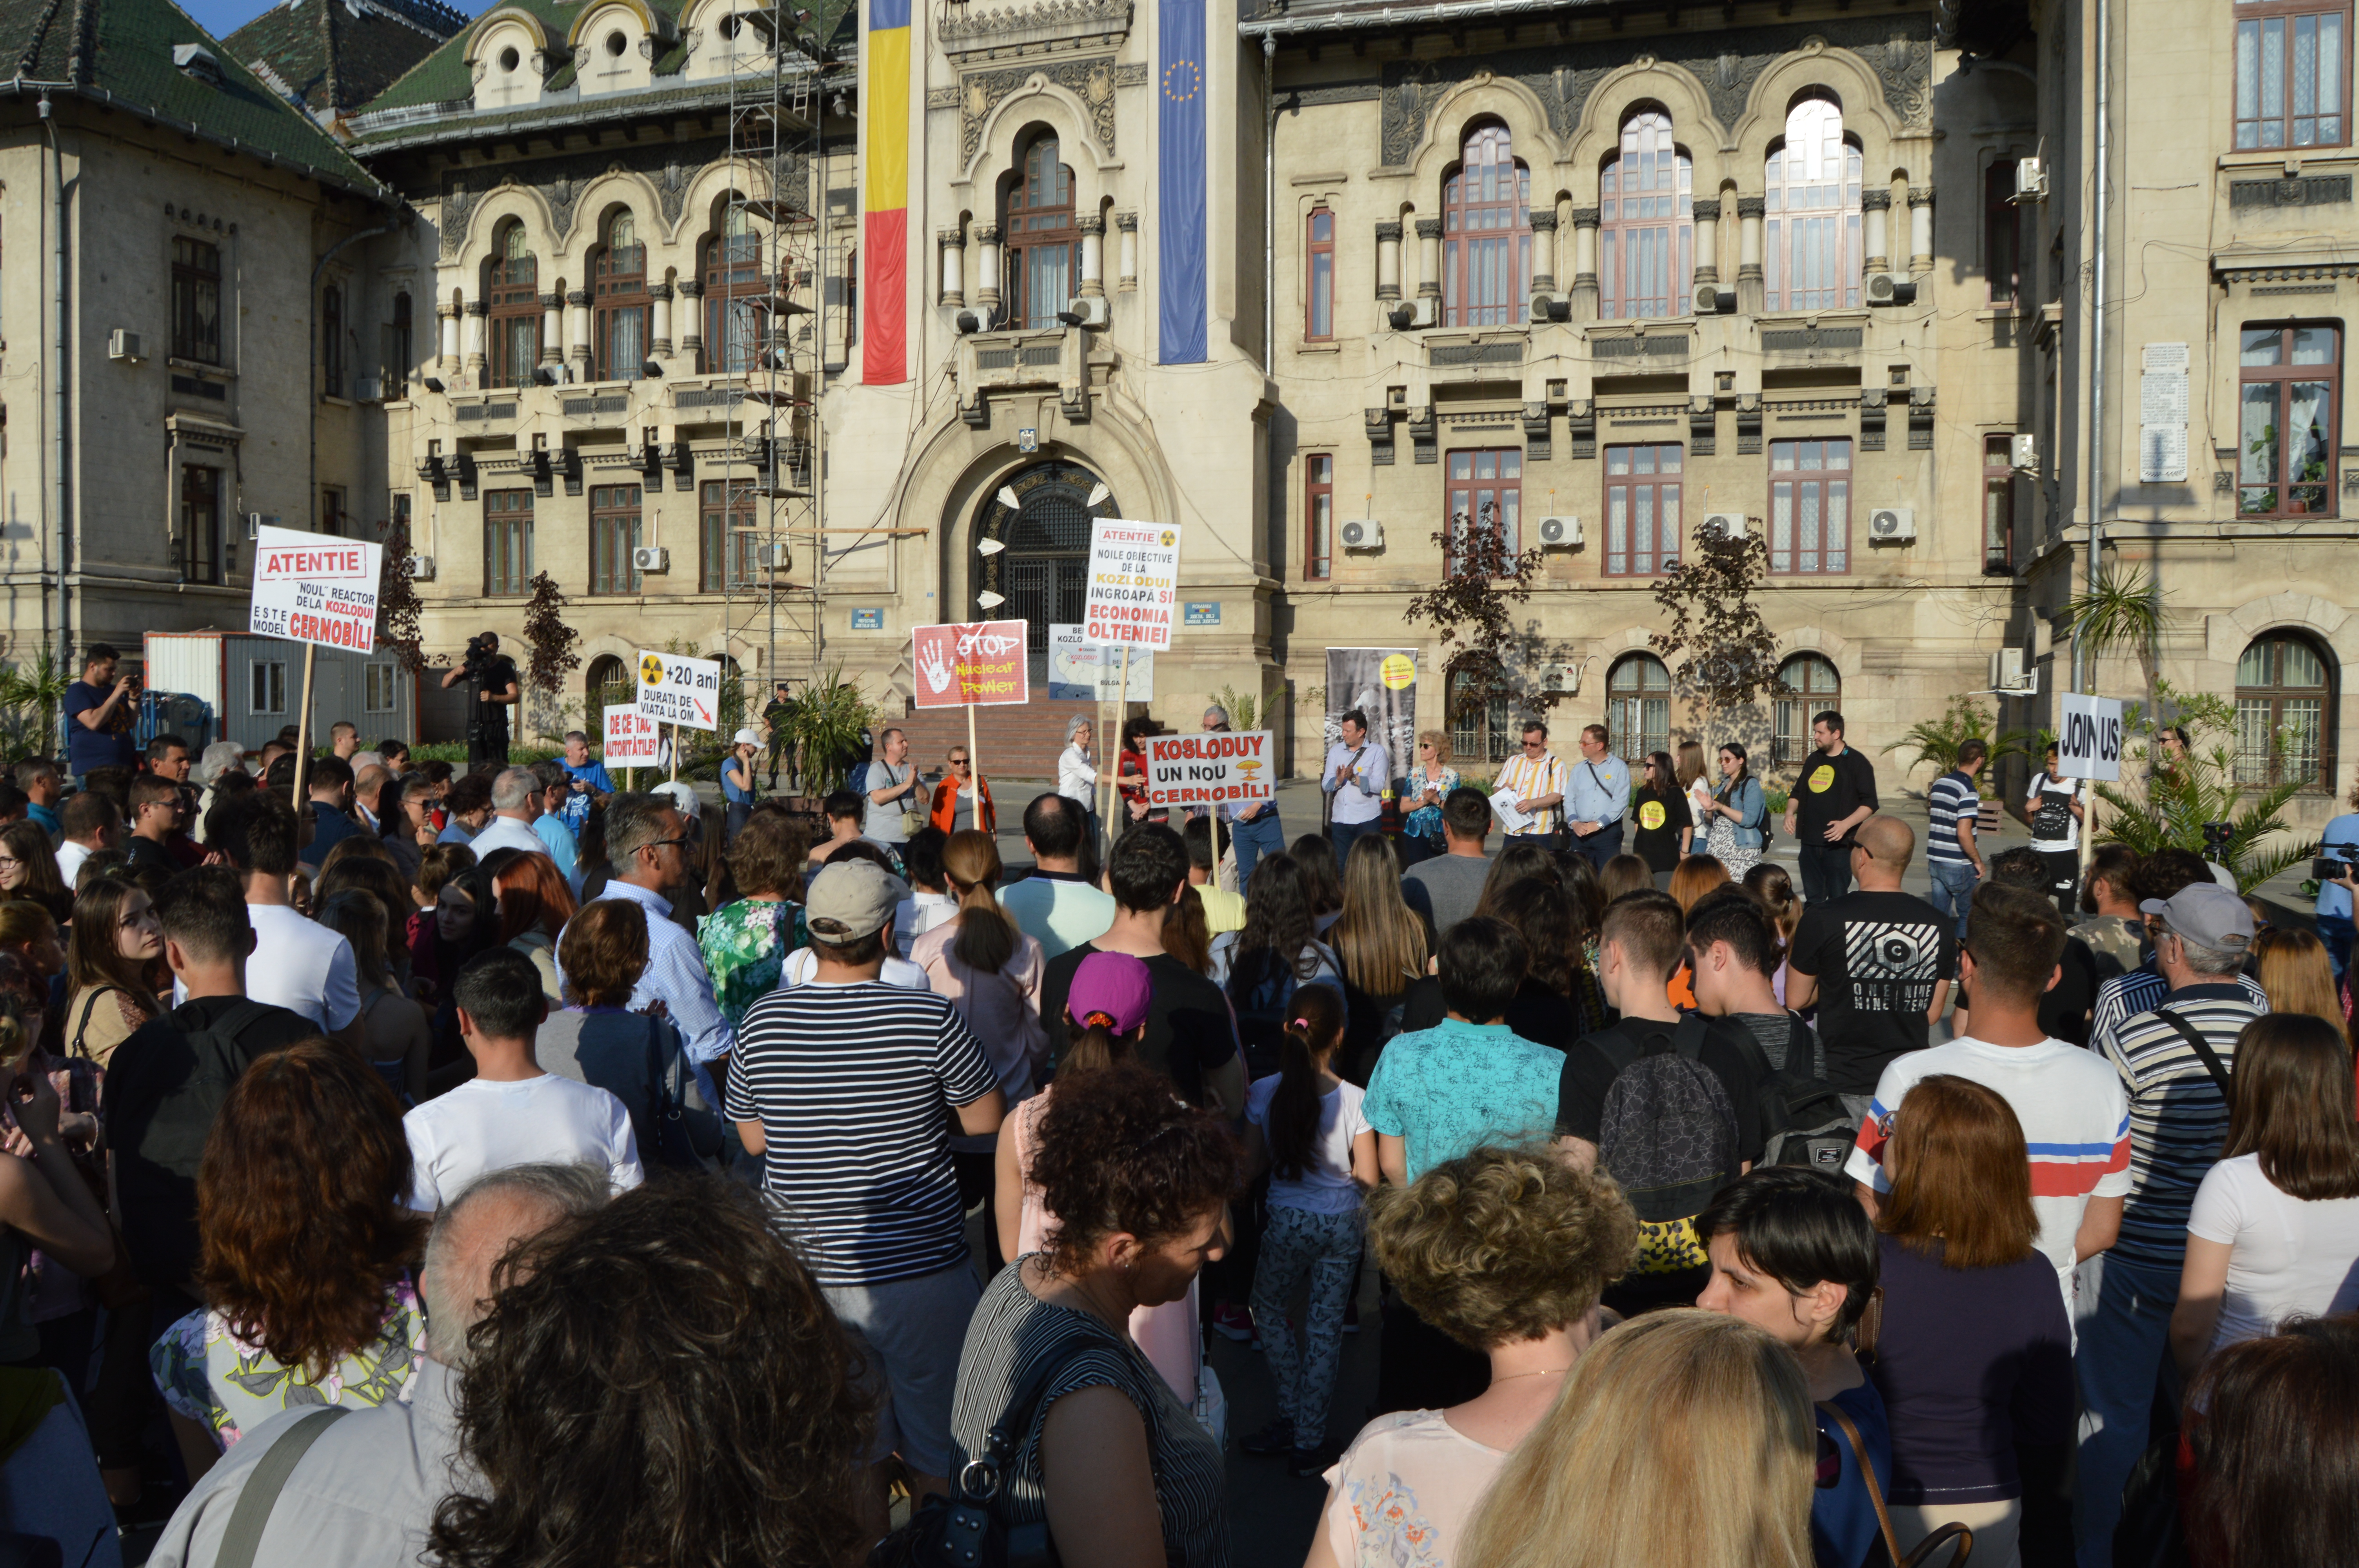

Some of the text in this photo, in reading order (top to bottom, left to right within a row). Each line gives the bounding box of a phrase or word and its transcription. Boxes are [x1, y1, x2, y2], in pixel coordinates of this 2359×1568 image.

[1103, 530, 1155, 542] ATENTIE
[267, 552, 358, 573] ATENTIE
[1098, 549, 1172, 563] NOILE OBIECTIVE
[1122, 563, 1146, 573] DE LA
[1096, 573, 1170, 588] KOZLODUI
[332, 588, 375, 605] REACTOR
[1091, 586, 1172, 604] INGROAPĂ SI
[254, 606, 287, 621] ESTE
[297, 596, 373, 619] DE LA KOZLODUI
[1090, 604, 1169, 624] ECONOMIA
[254, 613, 371, 650] MODEL CERNOBÎL!
[1088, 622, 1167, 644] OLTENIEI
[956, 633, 1020, 657] STOP
[667, 665, 717, 690] +20 ani
[955, 661, 1016, 677] Nuclear
[644, 689, 692, 708] DURATA DE
[641, 702, 694, 721] VIATA LA OM
[610, 713, 651, 735] DE CE TAC
[2062, 713, 2118, 761] JOIN US
[1153, 736, 1263, 761] KOSLODUY
[1157, 765, 1225, 782] UN NOU
[1152, 782, 1269, 803] CERNOBÎL!
[1891, 946, 1901, 956] C
[1854, 983, 1932, 998] ONE NINE
[1854, 996, 1928, 1012] NINE ZERO
